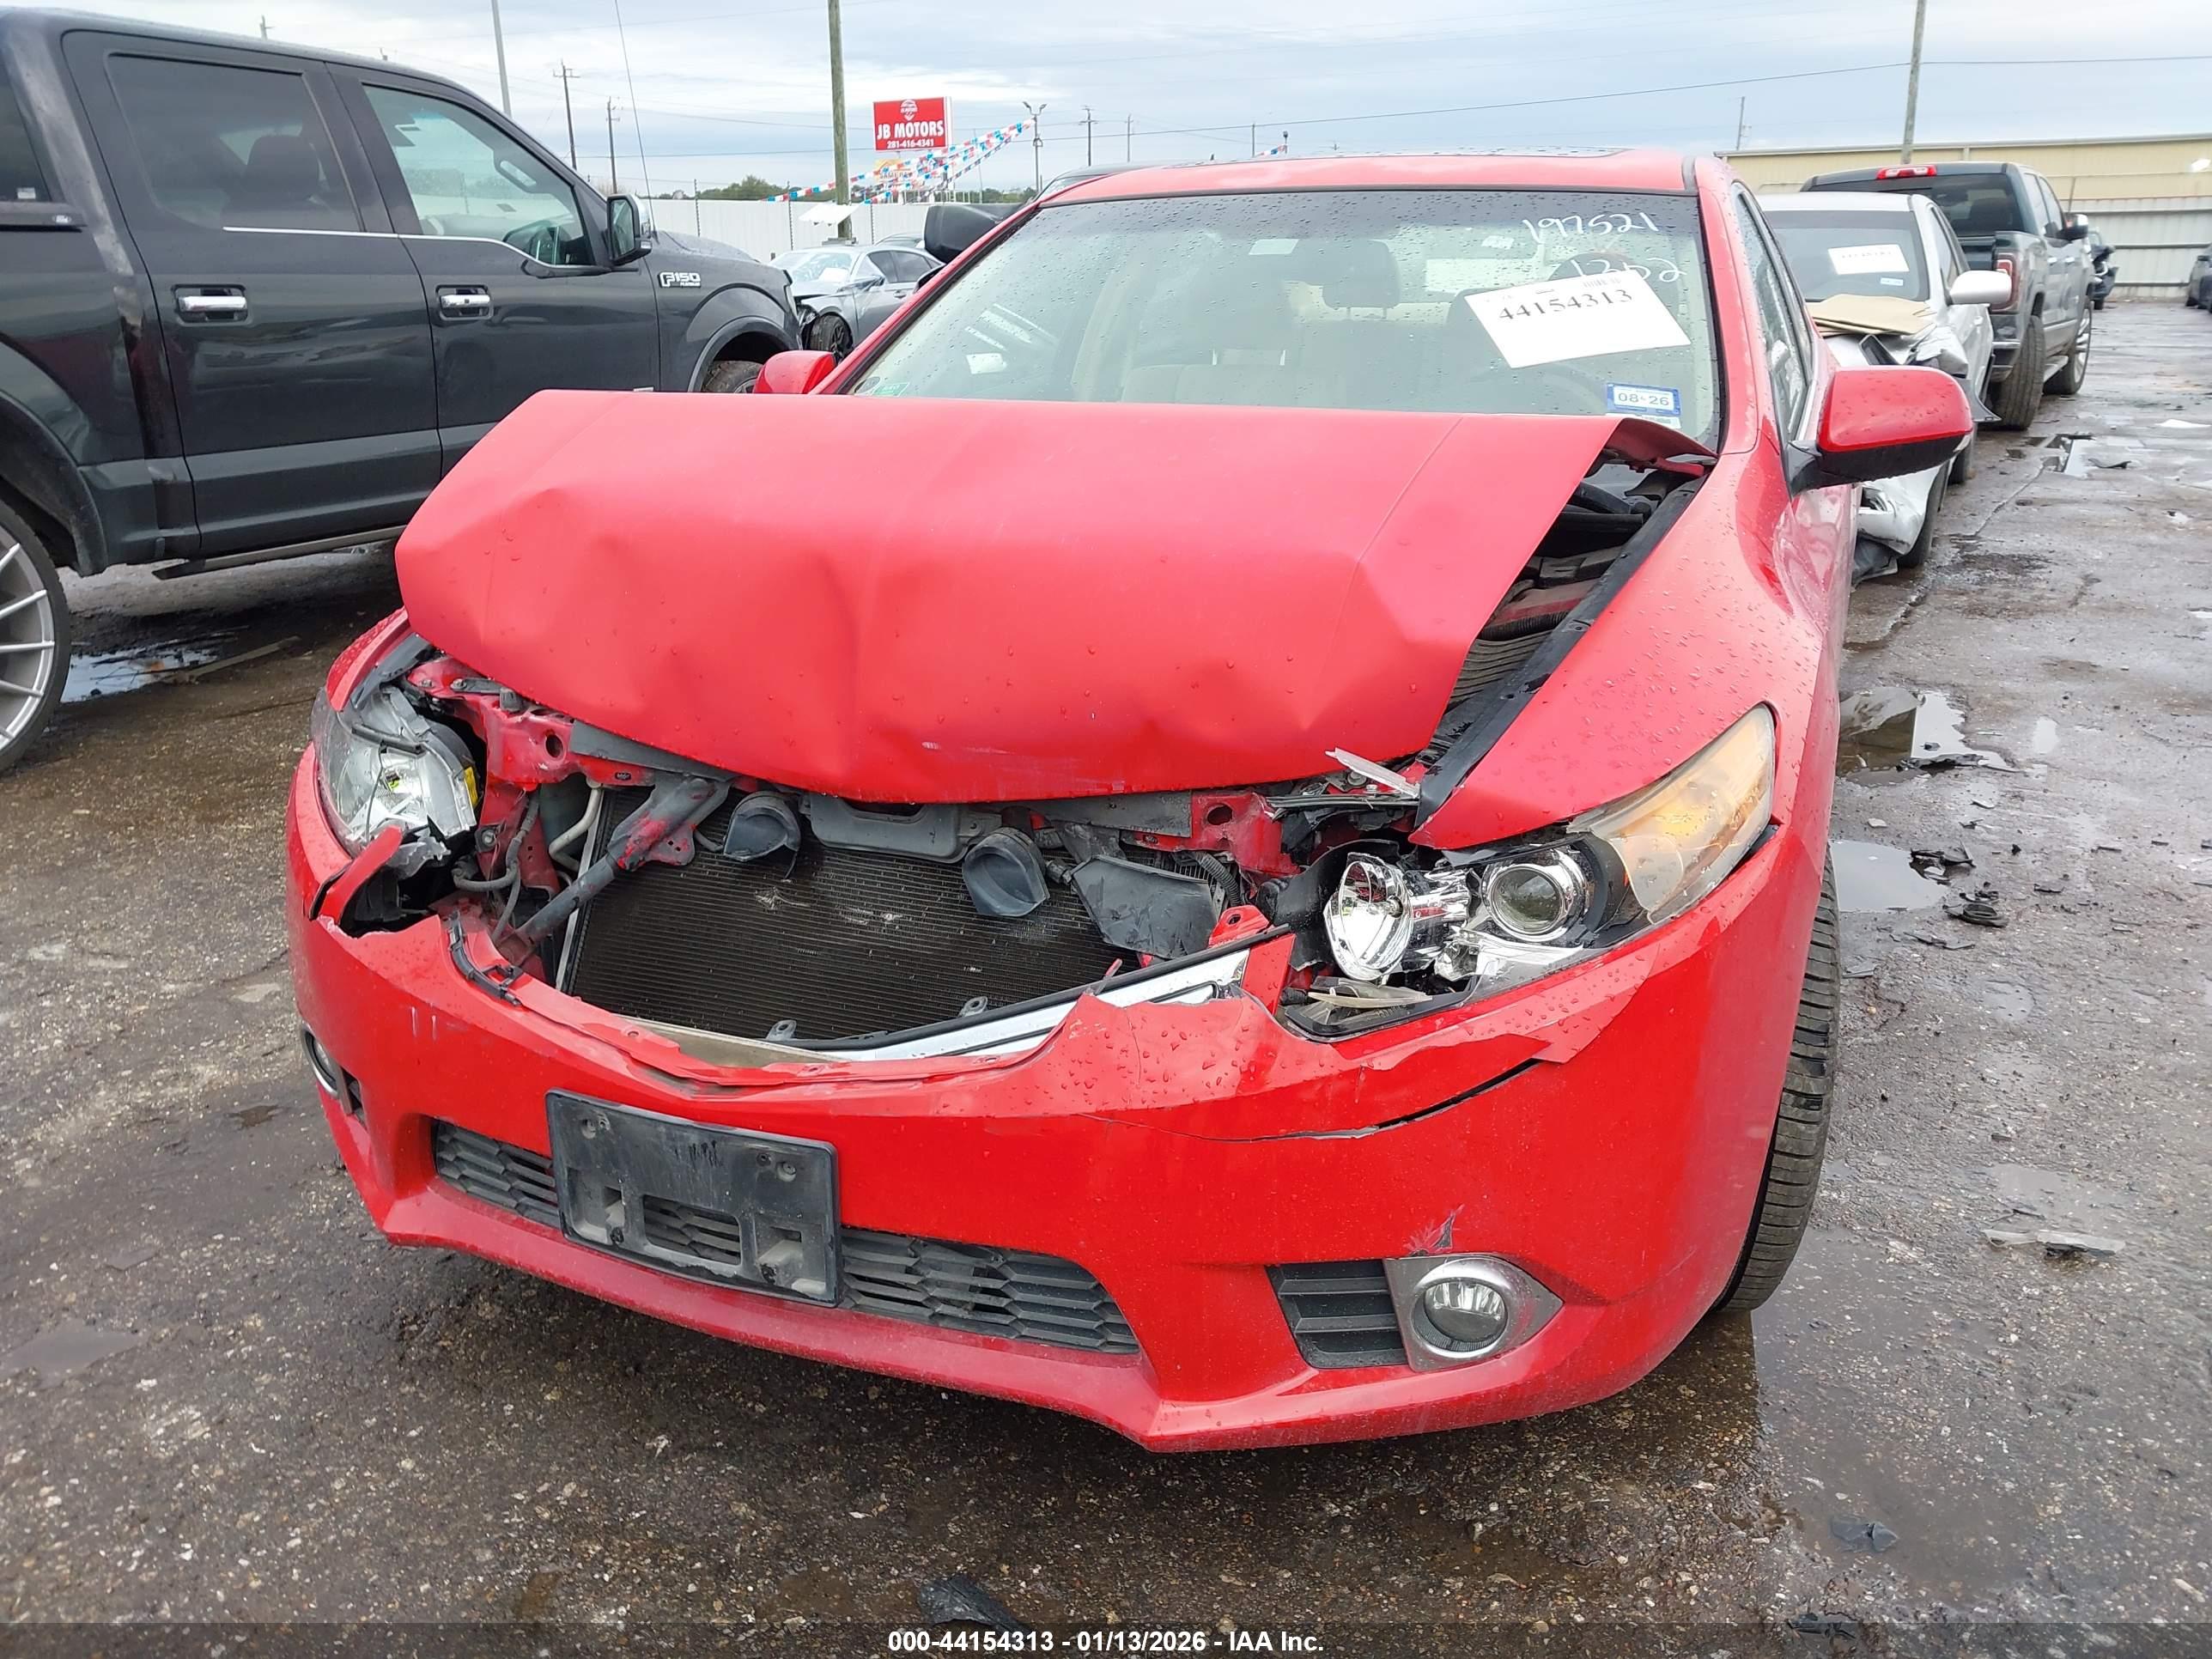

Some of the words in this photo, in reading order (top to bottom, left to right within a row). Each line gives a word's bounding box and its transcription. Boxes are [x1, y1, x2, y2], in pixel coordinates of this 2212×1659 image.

[877, 124, 890, 139] JB
[894, 120, 944, 137] MOTORS
[1498, 289, 1632, 319] 44154313
